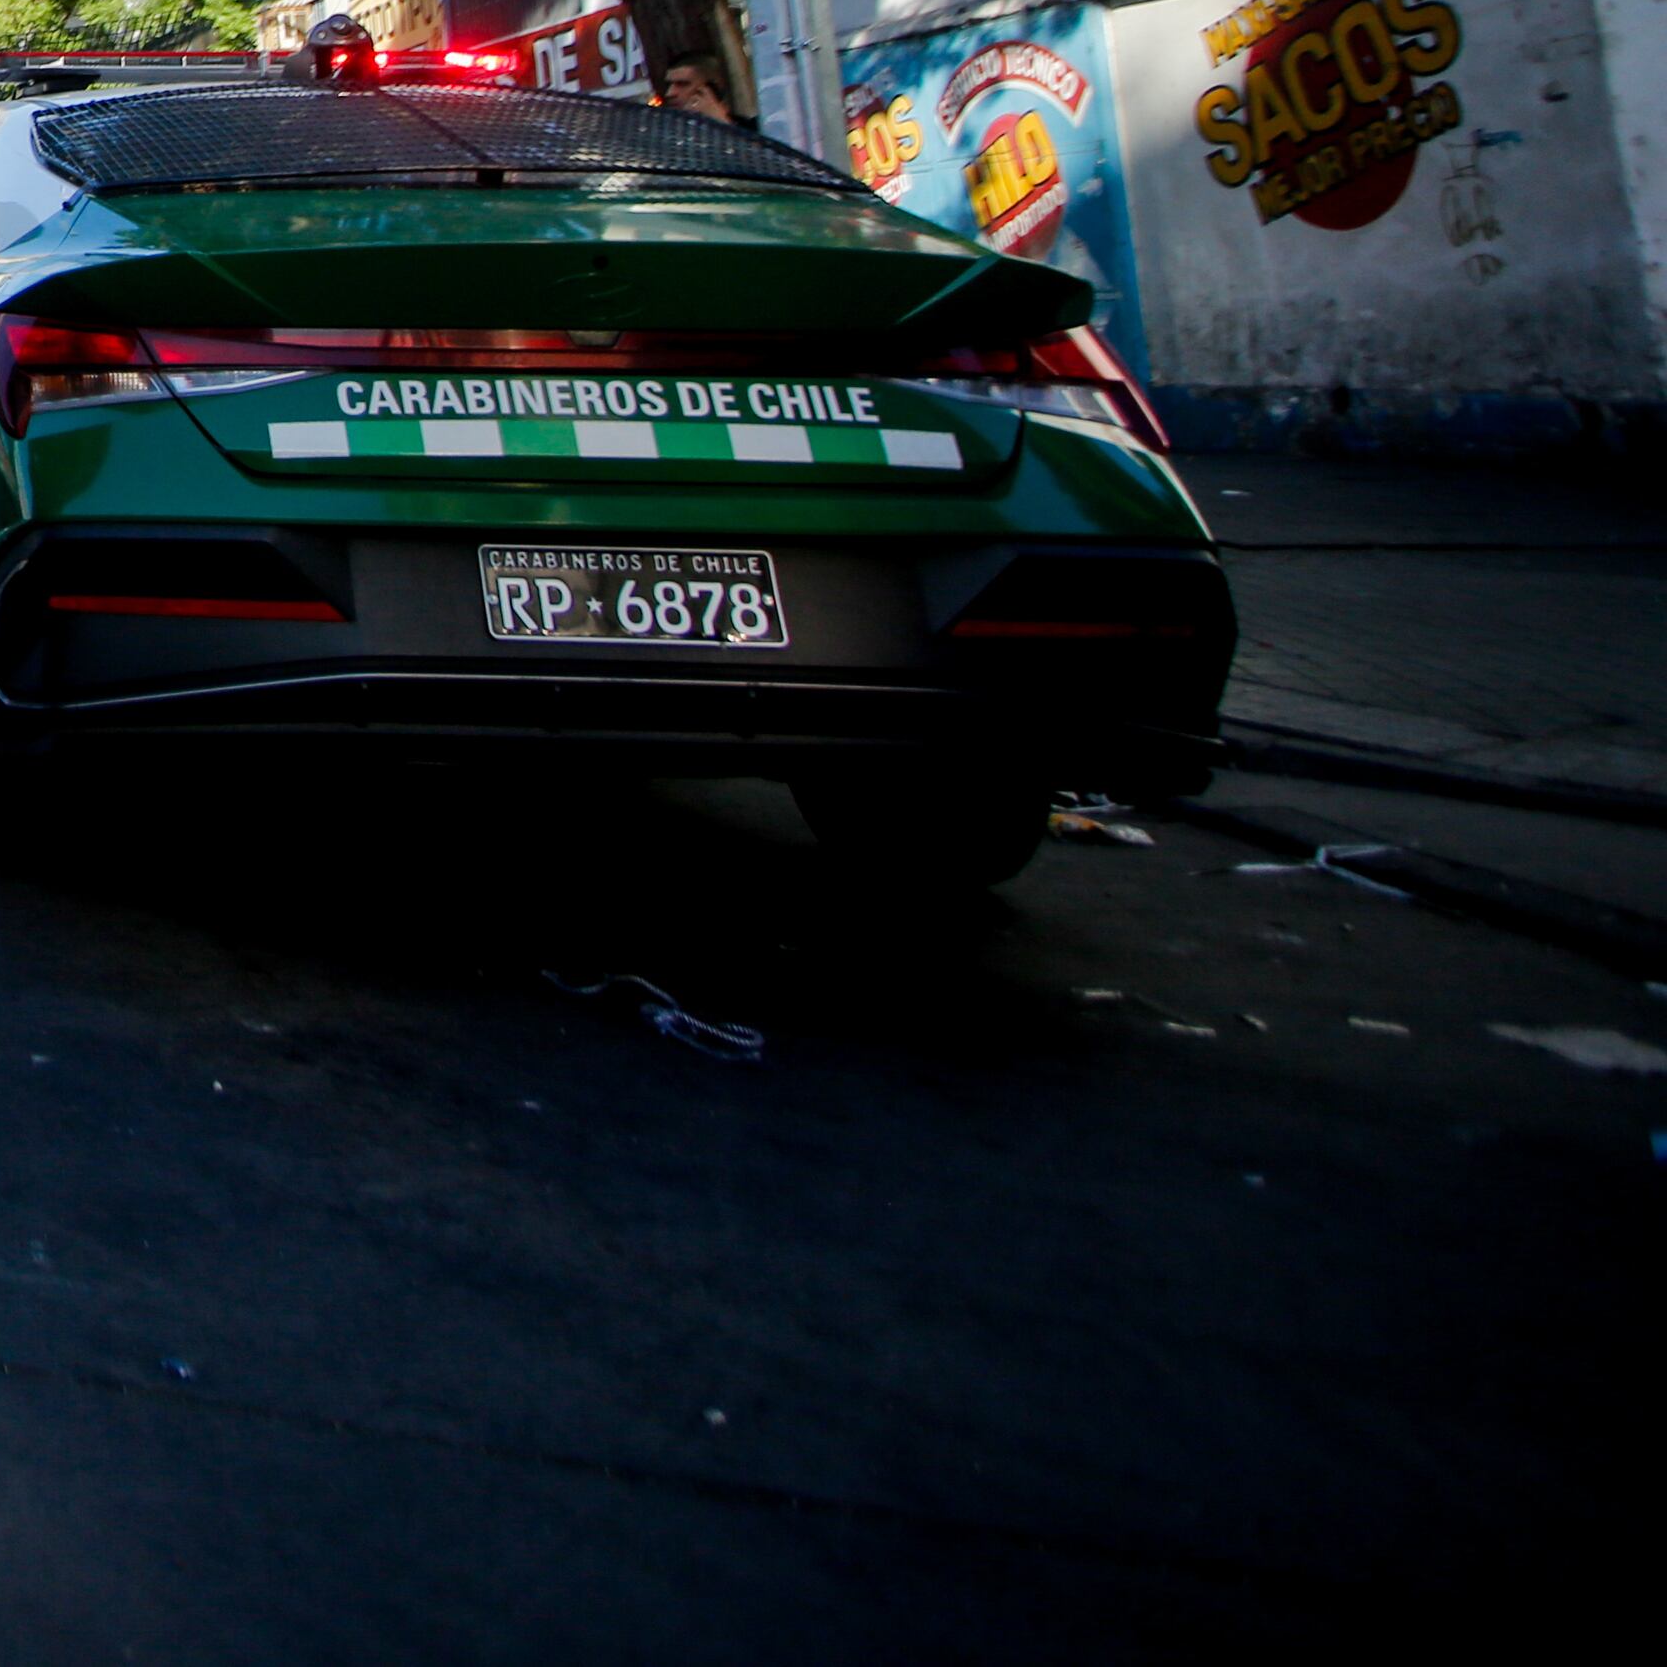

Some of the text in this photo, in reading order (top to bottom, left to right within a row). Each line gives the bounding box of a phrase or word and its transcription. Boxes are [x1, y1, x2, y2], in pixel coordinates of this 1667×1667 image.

[533, 28, 580, 94] DE
[963, 109, 1059, 230] HILO
[336, 380, 881, 424] CARABINEROS DE CHILE
[489, 550, 763, 574] CARABINEROS DE CHILE
[497, 577, 770, 637] RP 6878
